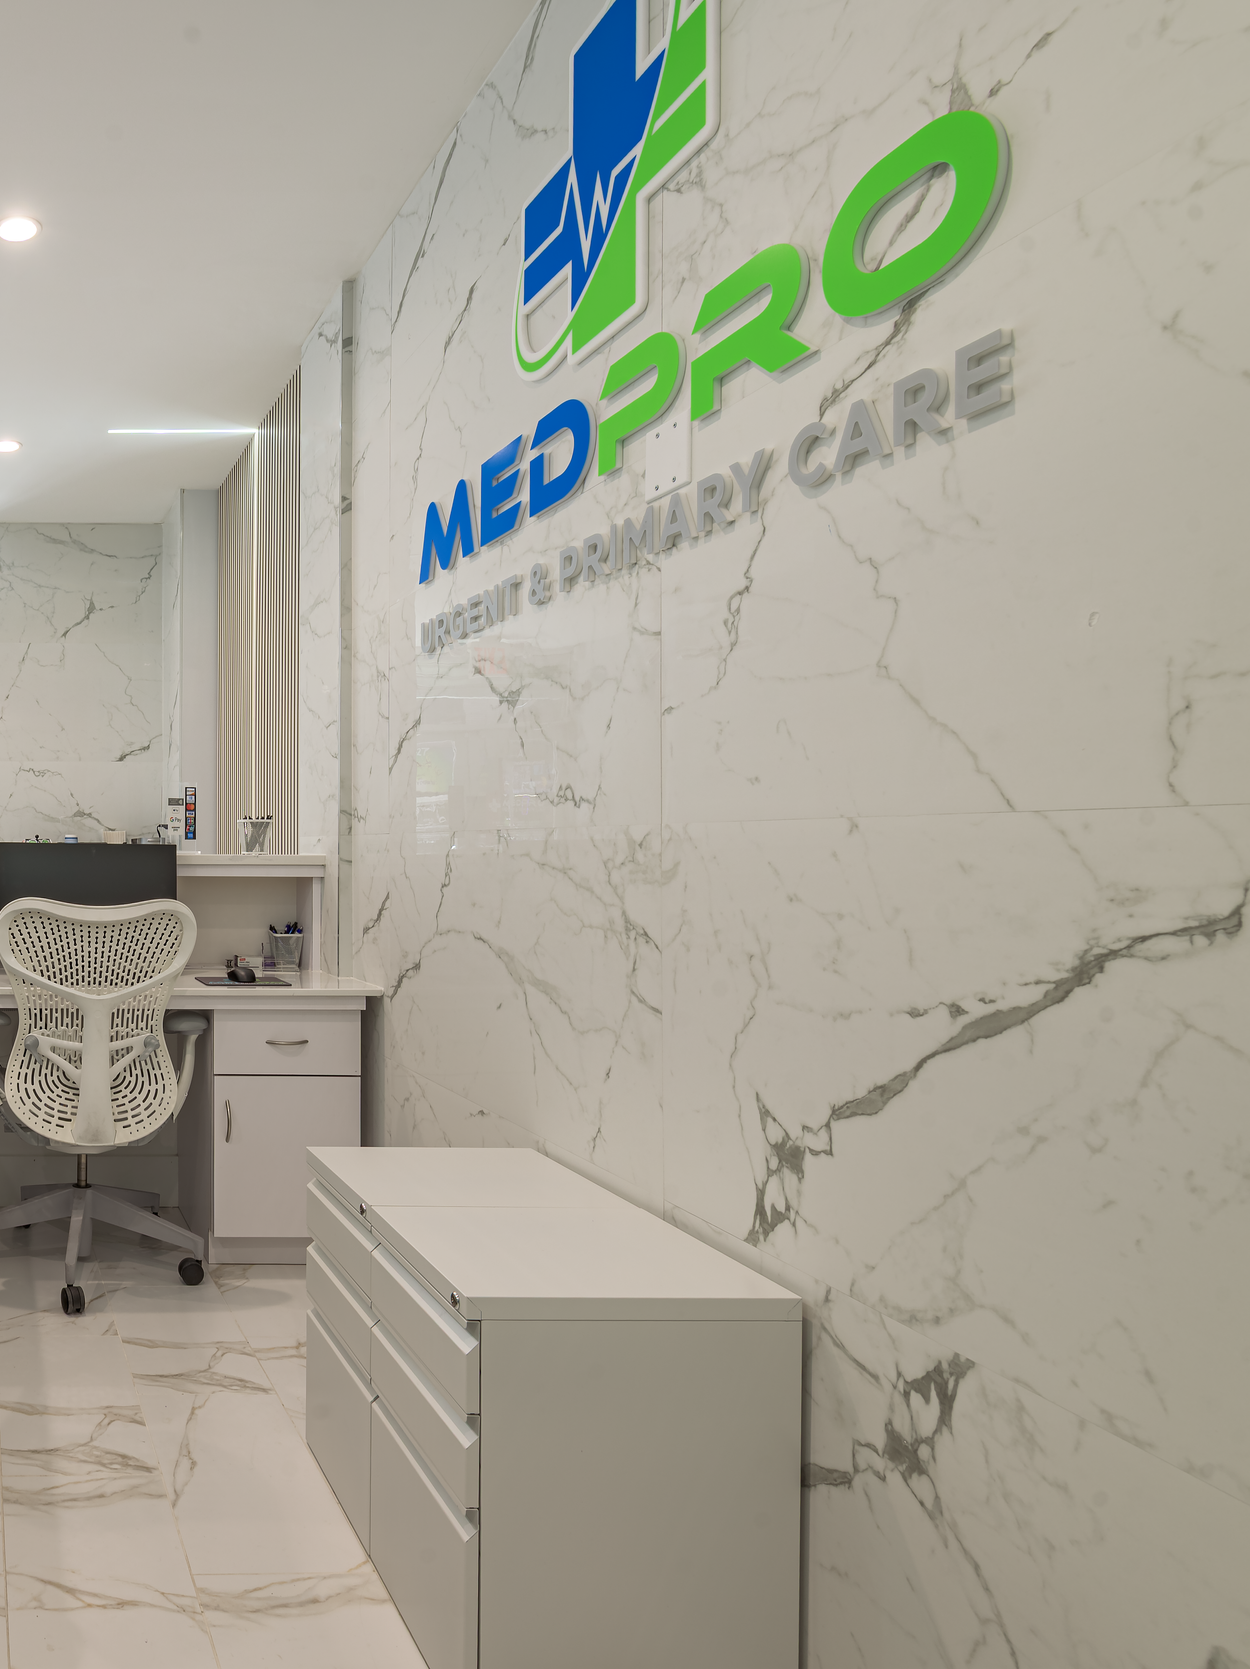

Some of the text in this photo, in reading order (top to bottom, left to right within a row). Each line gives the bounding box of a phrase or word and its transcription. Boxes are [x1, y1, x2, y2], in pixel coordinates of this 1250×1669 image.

[419, 110, 1004, 585] MEDPRO
[420, 328, 1007, 653] URGENT & PRIMARY CARE
